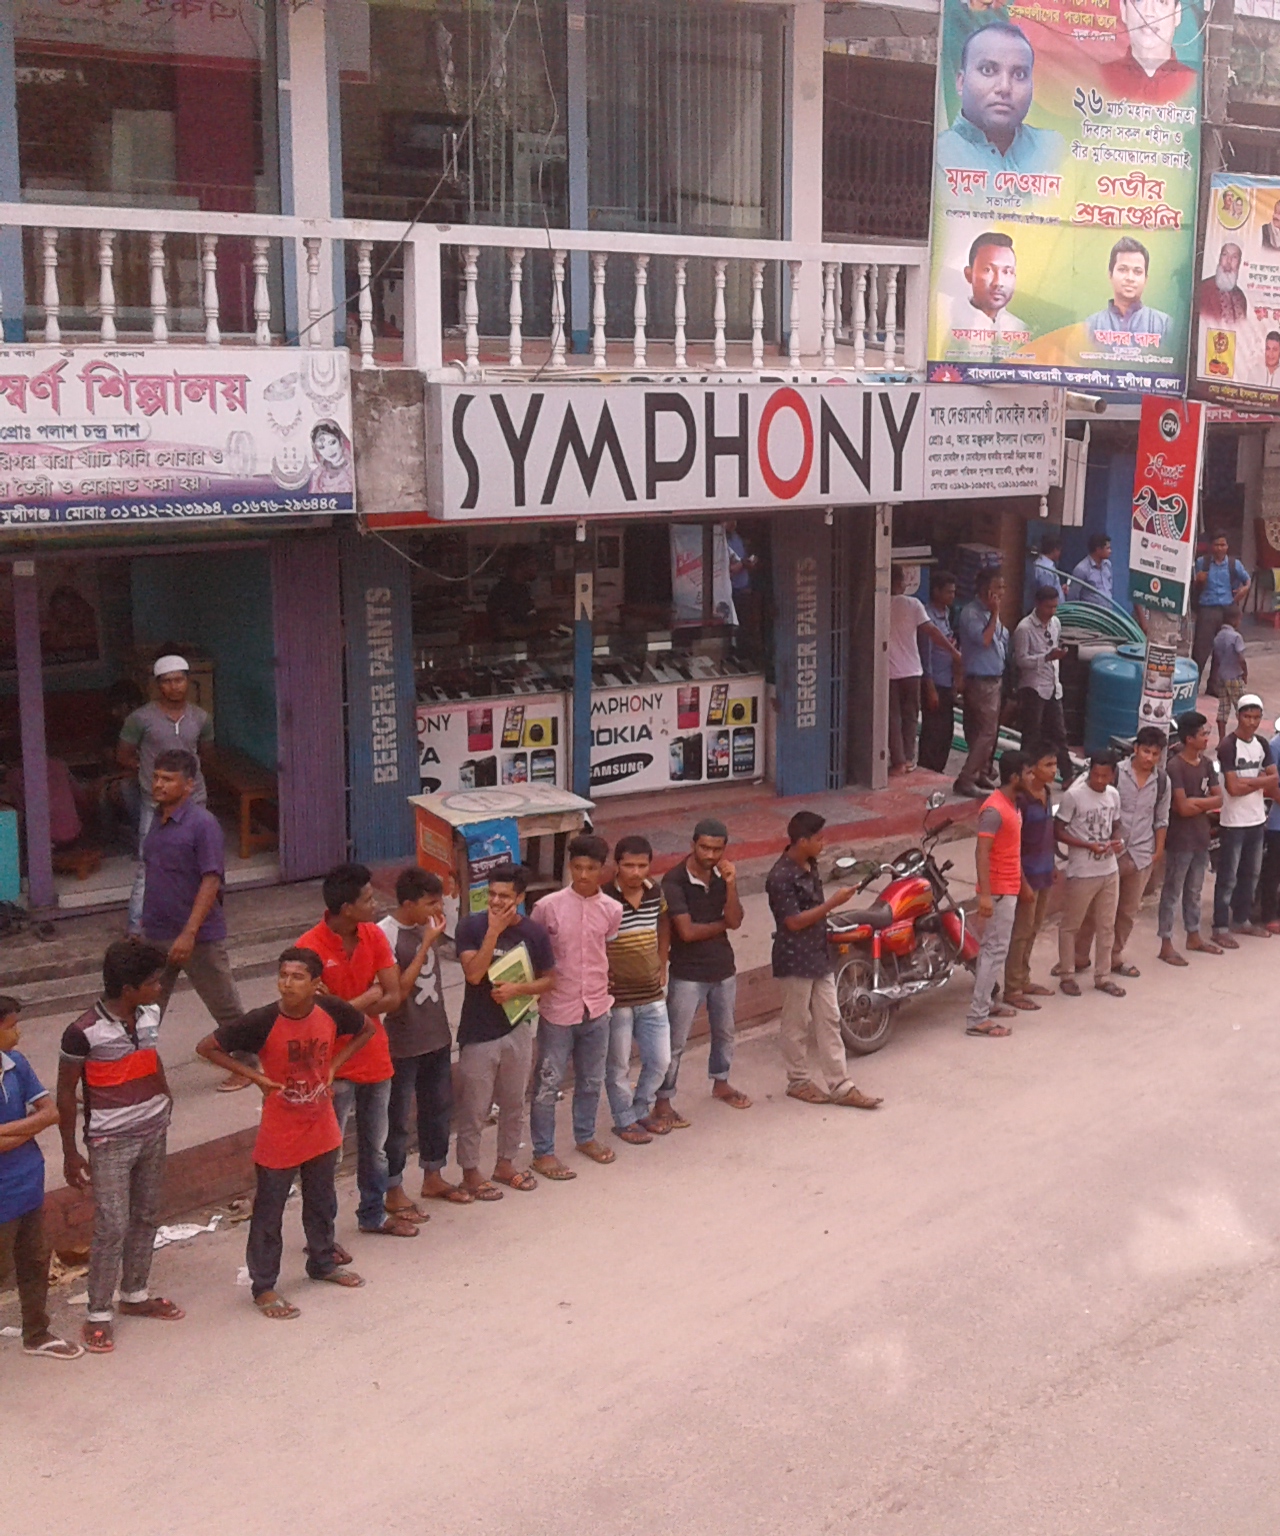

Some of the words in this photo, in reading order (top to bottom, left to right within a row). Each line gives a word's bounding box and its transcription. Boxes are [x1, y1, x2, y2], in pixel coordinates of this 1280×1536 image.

[1074, 87, 1103, 116] ২৬
[1106, 98, 1126, 118] মার্চ
[1127, 103, 1152, 121] মহান
[1144, 125, 1170, 144] শহীদ
[1174, 132, 1182, 143] ও
[1071, 140, 1088, 159] বীর
[1161, 149, 1192, 170] জানাই
[945, 168, 988, 197] মৃদুল
[994, 171, 1063, 196] দেওয়ান
[1097, 171, 1165, 200] গভীর
[986, 194, 1022, 208] সভাপতি
[967, 367, 1015, 379] বাংলাদেশ
[1018, 366, 1061, 382] আওয়ামী
[1154, 376, 1181, 390] জেলা
[37, 424, 77, 440] পলাশ
[82, 424, 108, 440] চন্দ্র
[112, 422, 140, 438] দাশ
[1163, 419, 1178, 433] GPH
[209, 450, 223, 465] ও
[452, 387, 921, 509] SYMPHONY
[58, 480, 73, 496] ও
[79, 477, 140, 496] মেরামত
[143, 476, 174, 493] করা
[797, 557, 818, 636] PAINTS
[365, 587, 393, 677] PAINTS
[796, 642, 818, 729] BERGER
[590, 693, 663, 716] MPHONY
[370, 683, 399, 784] BERGER
